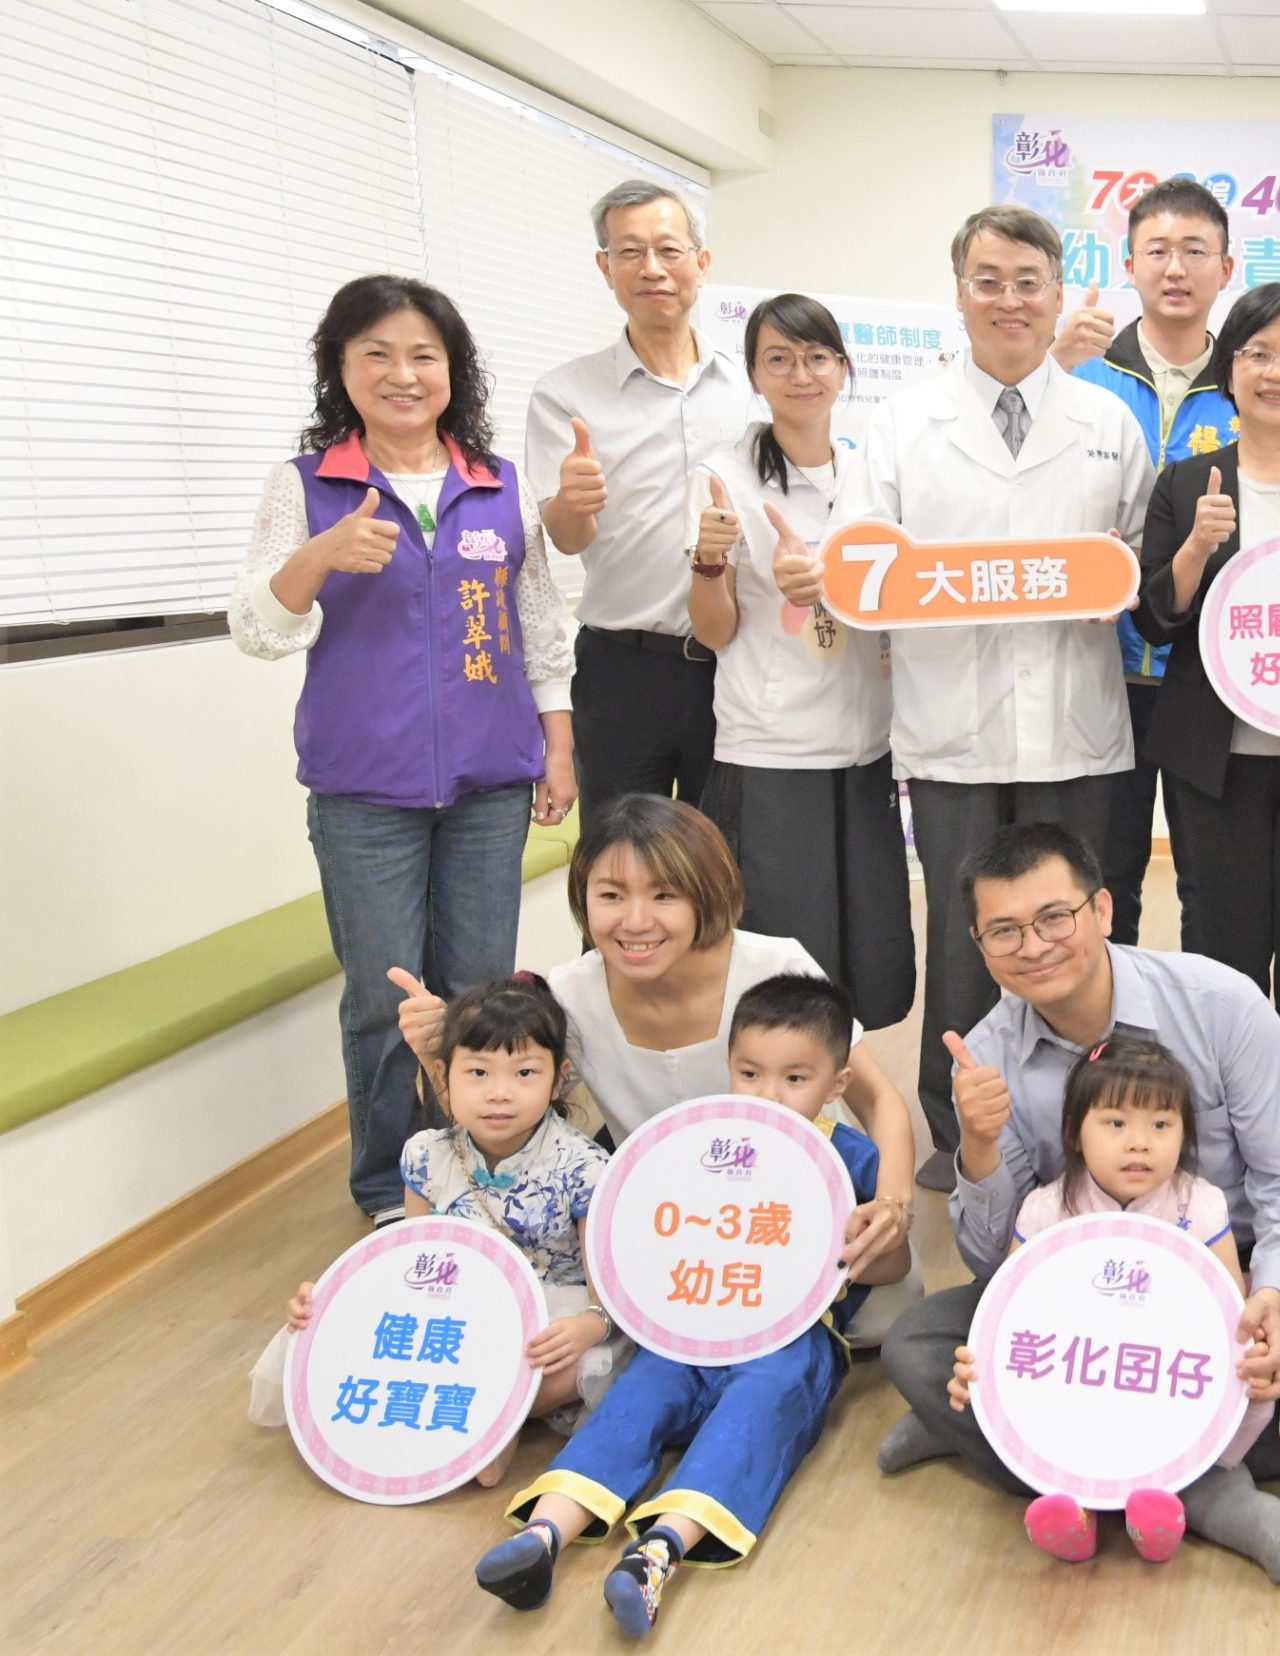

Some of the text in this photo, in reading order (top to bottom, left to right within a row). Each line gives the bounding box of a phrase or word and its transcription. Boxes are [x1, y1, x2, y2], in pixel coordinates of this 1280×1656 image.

[1014, 130, 1071, 168] 彰化
[457, 579, 498, 685] 許翠娥
[708, 1137, 758, 1168] 彰化
[654, 1201, 792, 1247] 0~3歲
[413, 1252, 460, 1286] 彰化
[667, 1258, 762, 1307] 幼兒
[1102, 1259, 1151, 1294] 彰化
[372, 1312, 467, 1365] 健康
[1006, 1329, 1213, 1400] 彰化囝仔
[331, 1375, 477, 1434] 好寶寶
